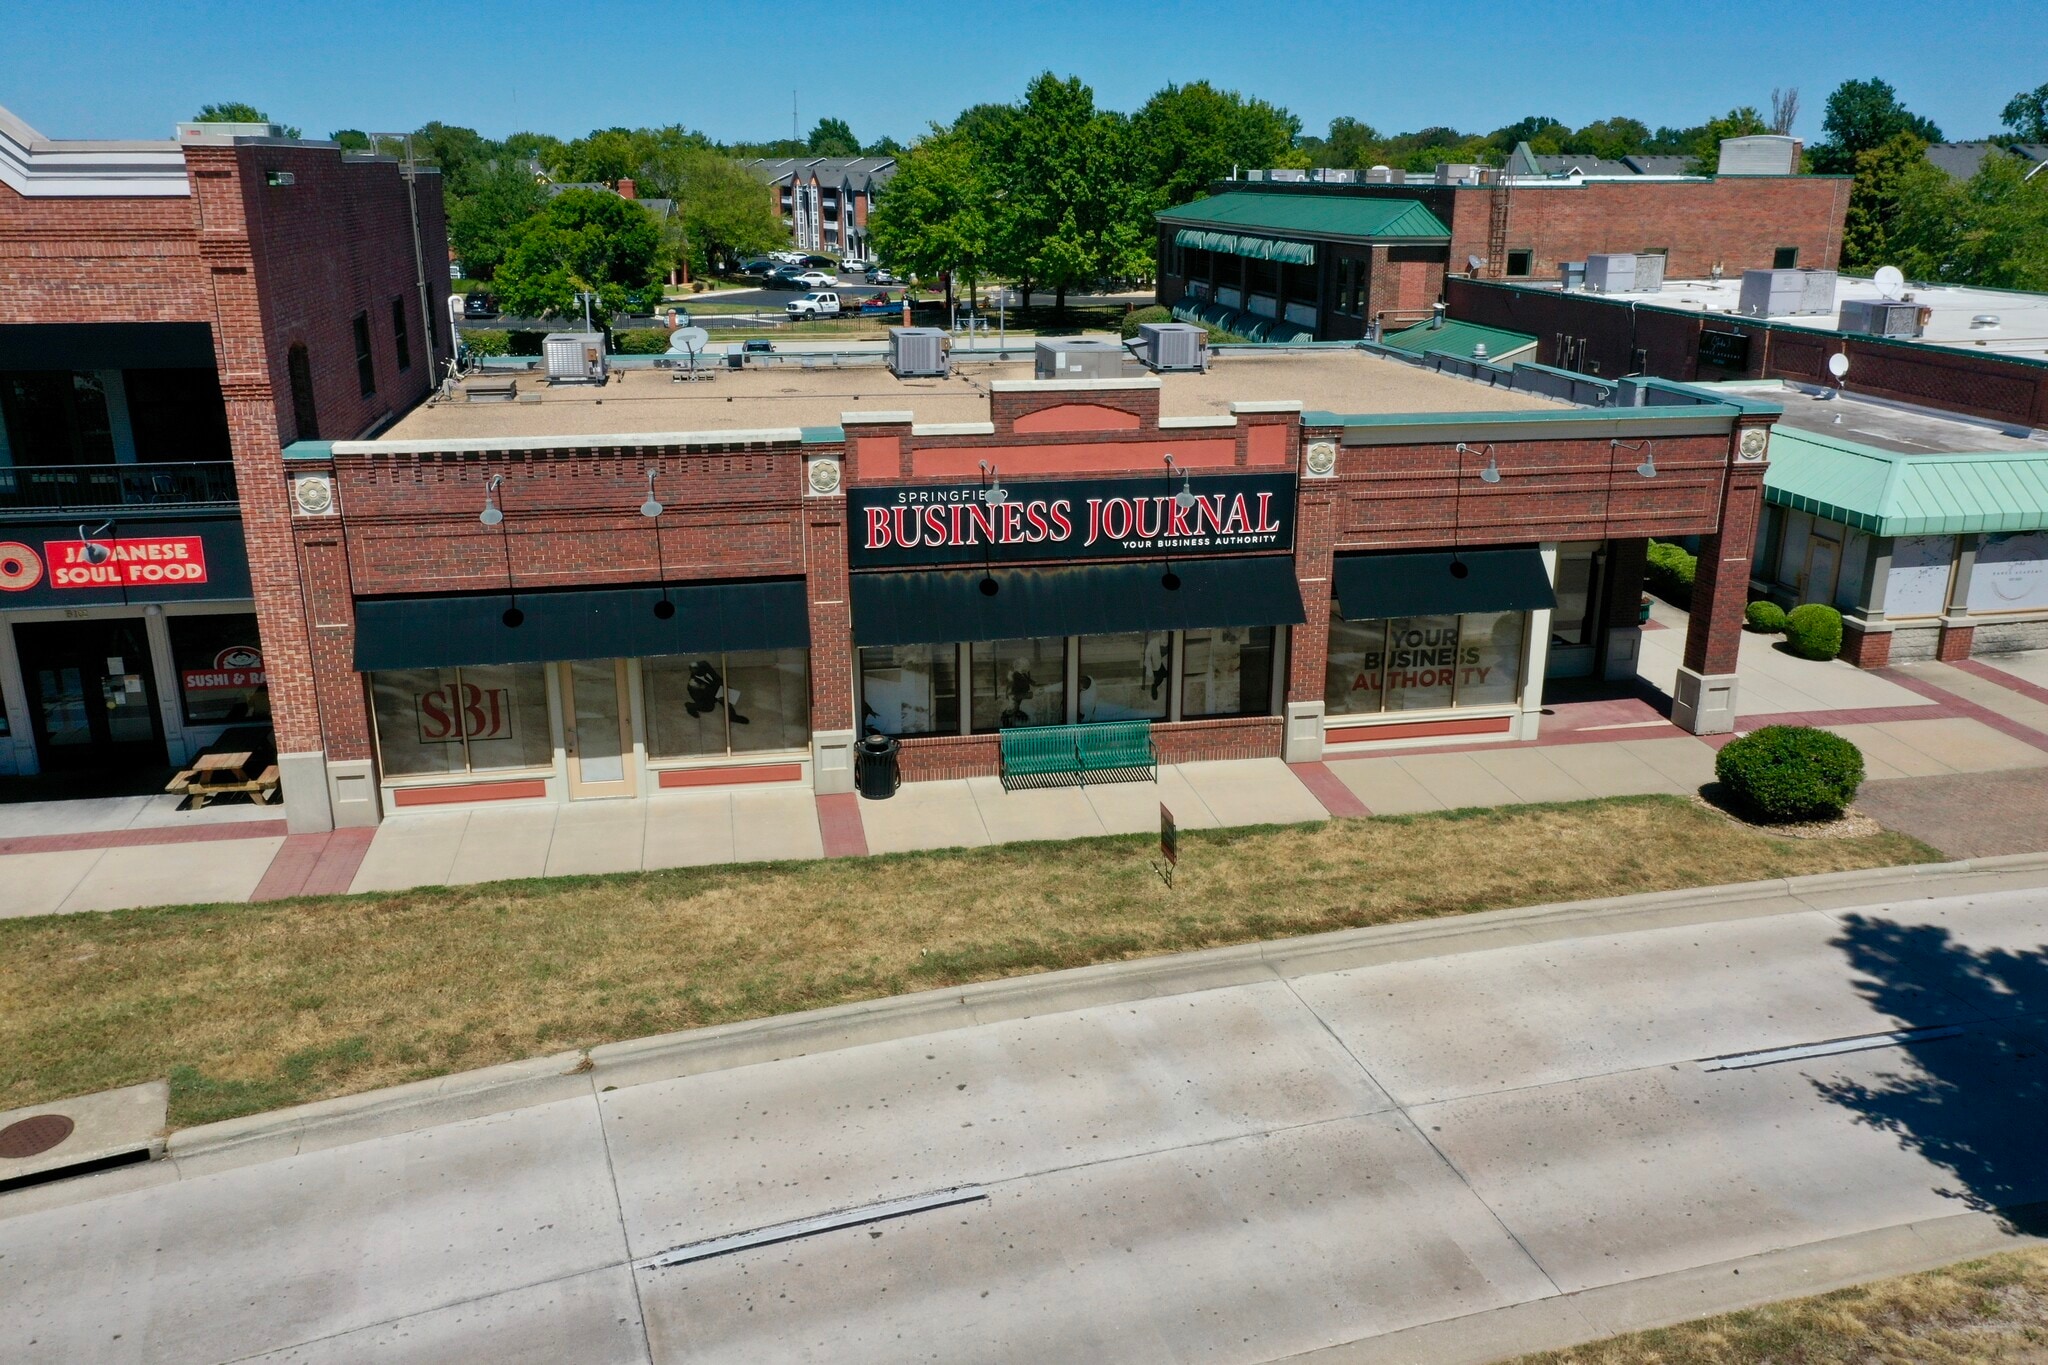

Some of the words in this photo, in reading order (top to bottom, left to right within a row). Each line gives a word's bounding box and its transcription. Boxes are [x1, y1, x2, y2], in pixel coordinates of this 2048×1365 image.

[898, 489, 1009, 503] SPRINGFIED
[863, 500, 1072, 549] BUSINESS
[1083, 492, 1280, 547] JOURNAL
[1122, 541, 1152, 549] YOUR
[1157, 538, 1210, 548] BUSINESS
[1215, 535, 1277, 545] AUTHORITY
[56, 566, 122, 584] SOUL
[130, 563, 202, 581] FOOD
[1390, 628, 1458, 648] YOUR
[186, 673, 229, 688] SUSHI
[233, 672, 245, 685] &
[1351, 666, 1492, 691] AUTHORTY
[421, 683, 501, 738] SBJ
